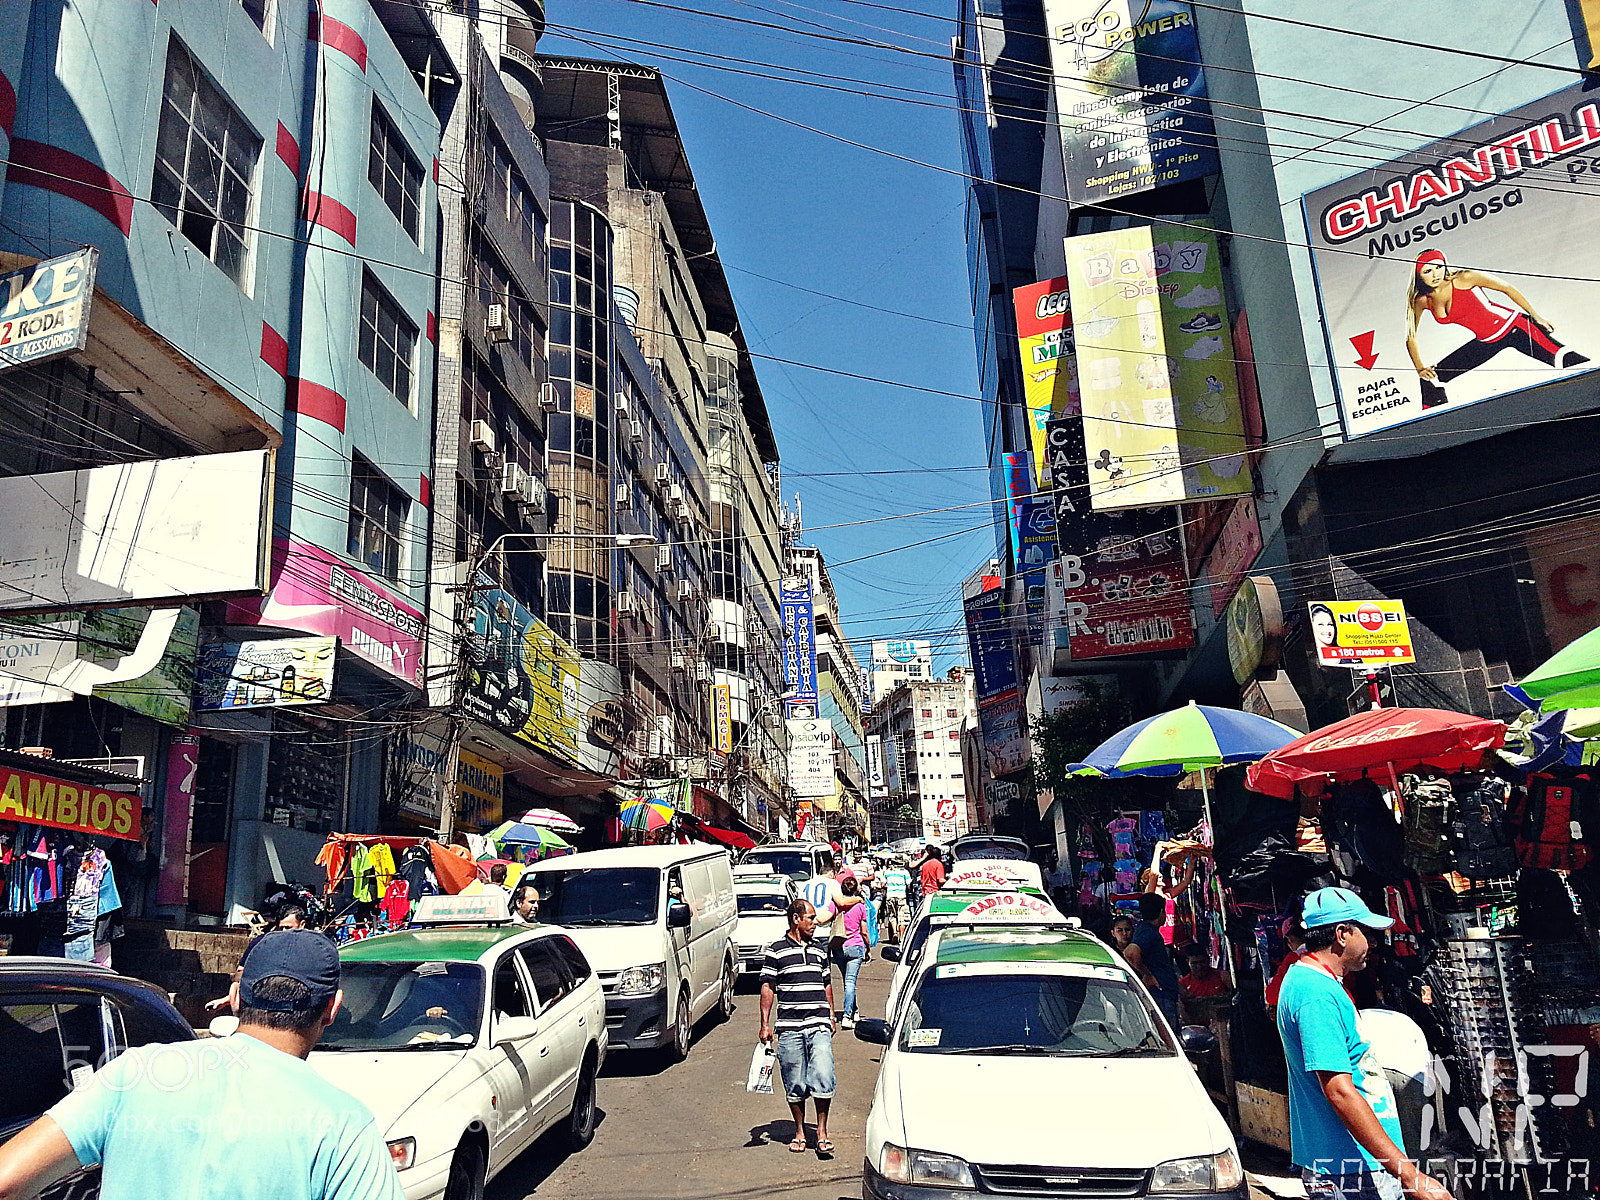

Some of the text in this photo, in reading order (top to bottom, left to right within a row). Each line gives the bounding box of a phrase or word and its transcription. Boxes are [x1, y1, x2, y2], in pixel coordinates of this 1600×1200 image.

[1054, 11, 1121, 45] ECO
[1104, 12, 1191, 48] POWER
[1172, 76, 1190, 89] de
[1089, 135, 1107, 149] de
[1085, 170, 1130, 188] Shopping
[1178, 153, 1200, 164] Piso
[1095, 155, 1106, 168] y
[1108, 169, 1181, 195] Lojas: 102/103
[1368, 187, 1524, 260] Musculosa
[1086, 248, 1202, 280] Baby
[1035, 289, 1071, 319] LEG
[0, 321, 13, 346] 2
[1357, 376, 1396, 394] BAJAR
[1357, 386, 1401, 405] POR LA
[1351, 395, 1411, 420] ESCALERA
[1023, 533, 1057, 544] Asistenci
[1339, 611, 1402, 624] NISSEI
[351, 626, 394, 668] PUMA
[1355, 647, 1385, 657] metros
[718, 688, 729, 750] FARMACIA
[0, 773, 133, 834] AMBIOS
[951, 871, 983, 885] RADIO
[802, 882, 827, 909] 10
[966, 895, 1015, 916] RADIO
[1019, 896, 1052, 917] TAXI
